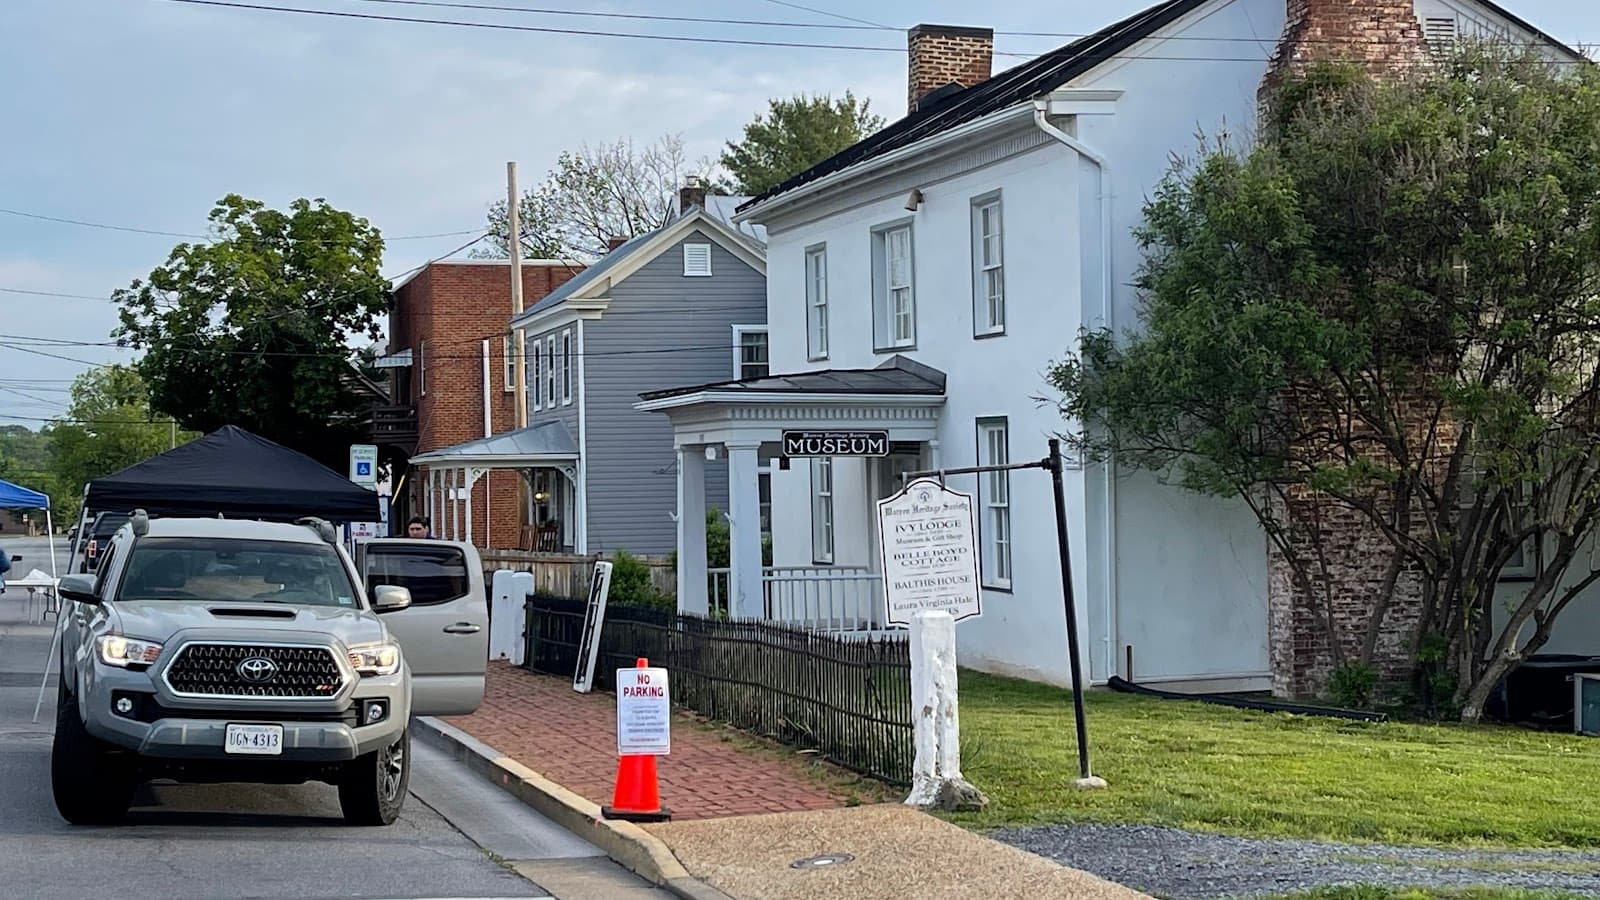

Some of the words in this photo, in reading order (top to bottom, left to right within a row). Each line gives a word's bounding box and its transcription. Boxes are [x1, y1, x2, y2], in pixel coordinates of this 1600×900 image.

[788, 439, 884, 453] MUSEUM
[912, 504, 940, 514] Heritage
[942, 502, 968, 511] Society
[896, 524, 916, 533] IVY
[920, 520, 961, 530] LODGE
[894, 550, 930, 560] BELLE
[932, 547, 968, 556] BOYD
[901, 556, 960, 566] COTTAGE
[894, 578, 936, 590] BALTHIS
[938, 575, 971, 585] HOUSE
[894, 602, 918, 610] Laura
[919, 598, 952, 608] Virginia
[954, 596, 973, 604] Hale
[637, 675, 650, 684] NO
[624, 686, 663, 697] PARKING
